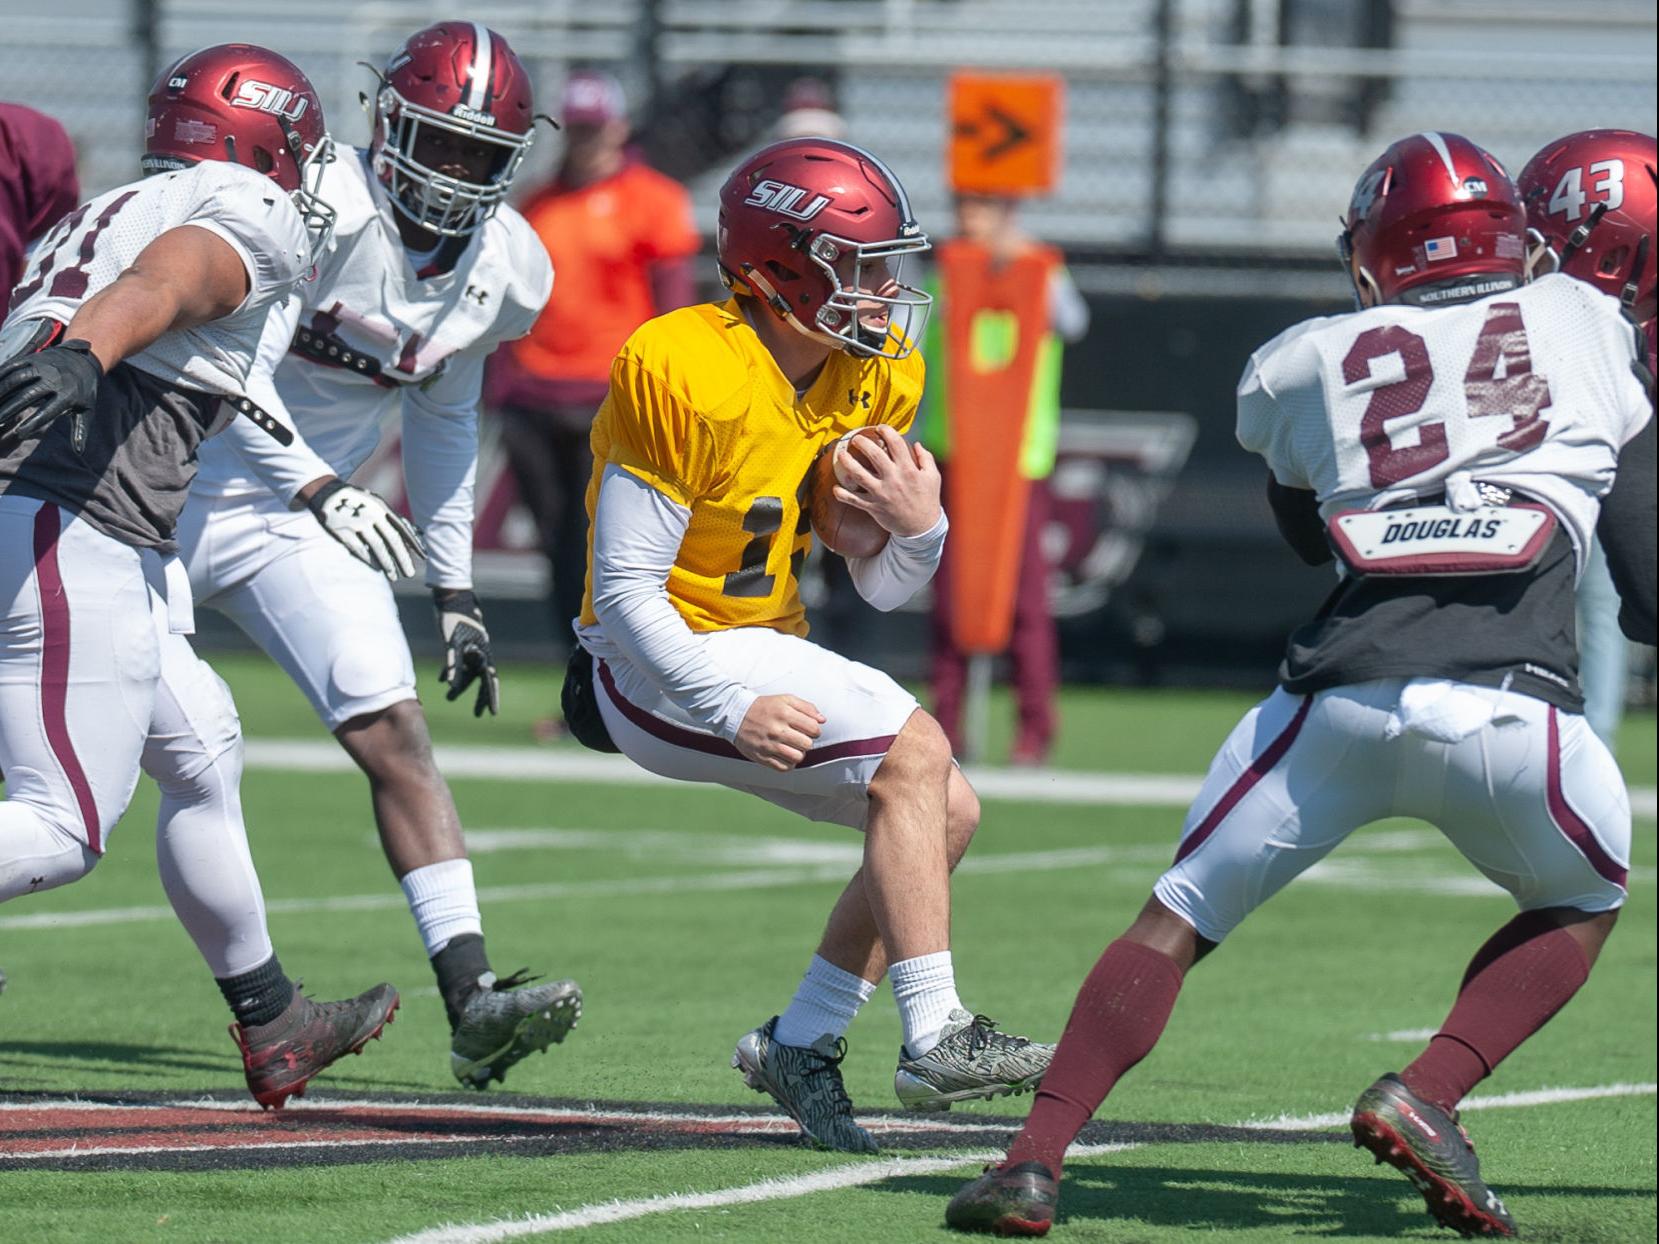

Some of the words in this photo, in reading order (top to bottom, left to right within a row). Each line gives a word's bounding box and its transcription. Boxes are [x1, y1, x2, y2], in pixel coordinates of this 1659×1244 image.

[168, 77, 188, 89] CM
[231, 80, 309, 122] SIU
[453, 103, 496, 127] Riddell
[744, 179, 832, 221] SIU
[1549, 159, 1623, 222] 43
[1419, 284, 1475, 302] SOUTHERN
[1343, 302, 1551, 489] 24
[1381, 519, 1501, 544] DOUGLAS
